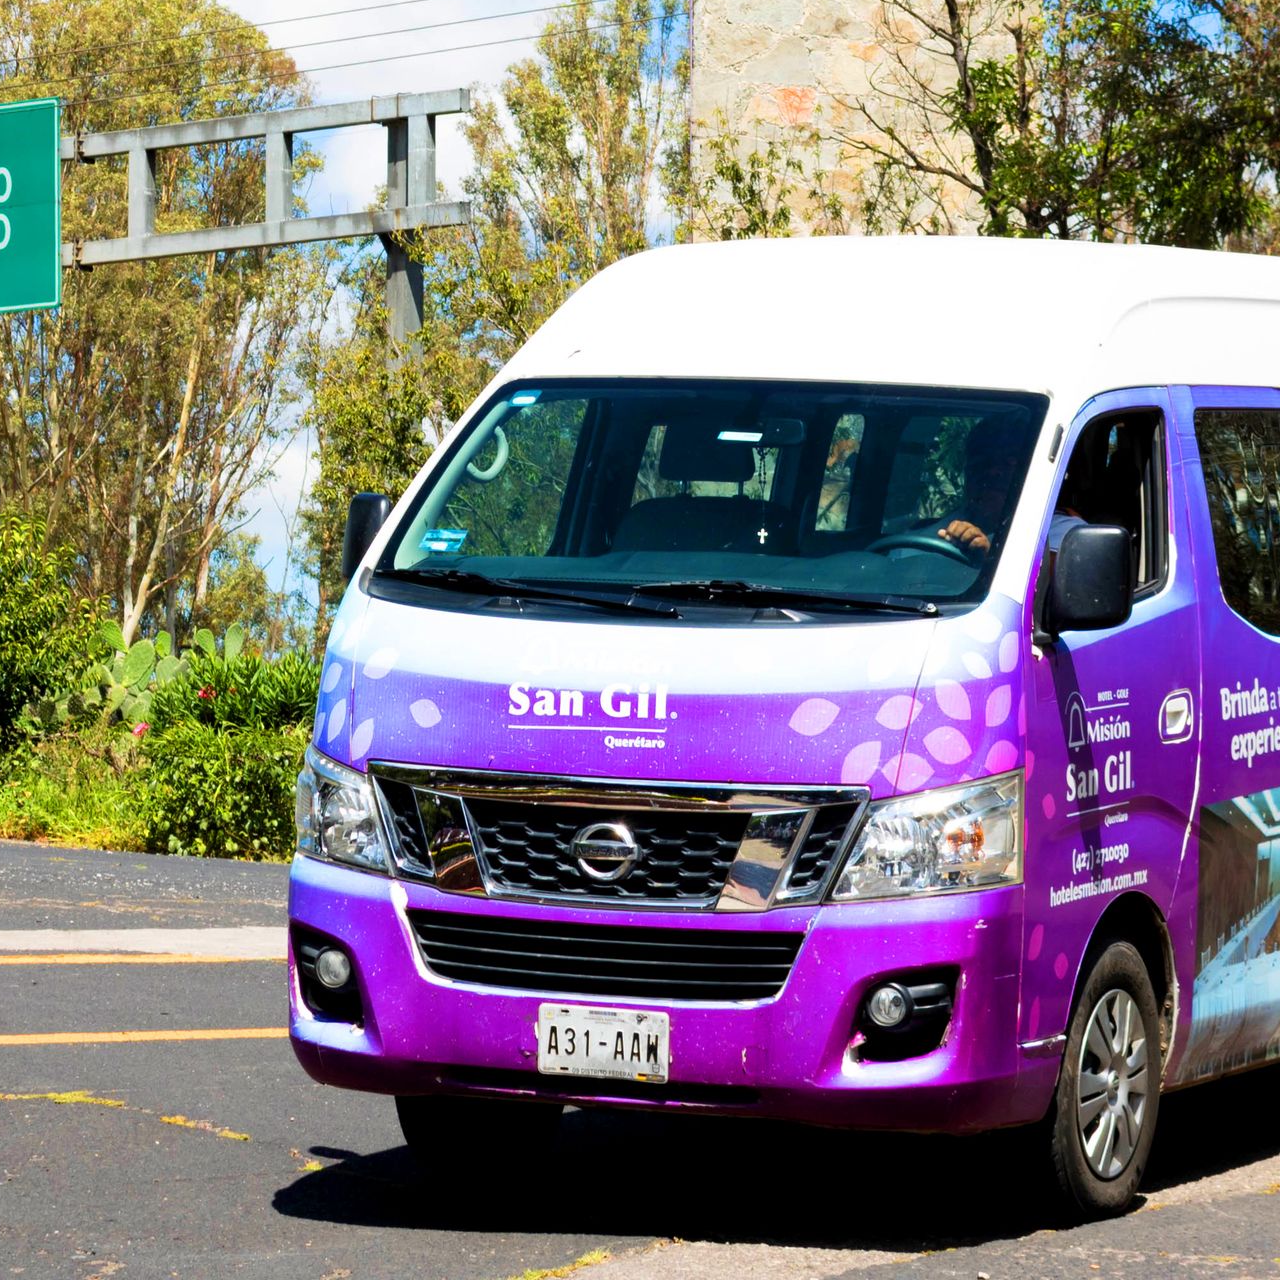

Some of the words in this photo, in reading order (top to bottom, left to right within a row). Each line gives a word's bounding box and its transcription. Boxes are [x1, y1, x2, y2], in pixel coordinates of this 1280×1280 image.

[508, 681, 584, 716] San
[600, 682, 668, 719] Gil
[1220, 677, 1269, 720] Brinda
[1270, 691, 1277, 710] a
[604, 735, 666, 749] Querétaro
[1087, 715, 1131, 744] Misión
[1066, 763, 1099, 802] San
[1104, 750, 1131, 793] Gil
[1072, 845, 1094, 875] (427)
[1050, 869, 1148, 907] hotelesmision.com.mx
[547, 1025, 659, 1064] A31-AAW
